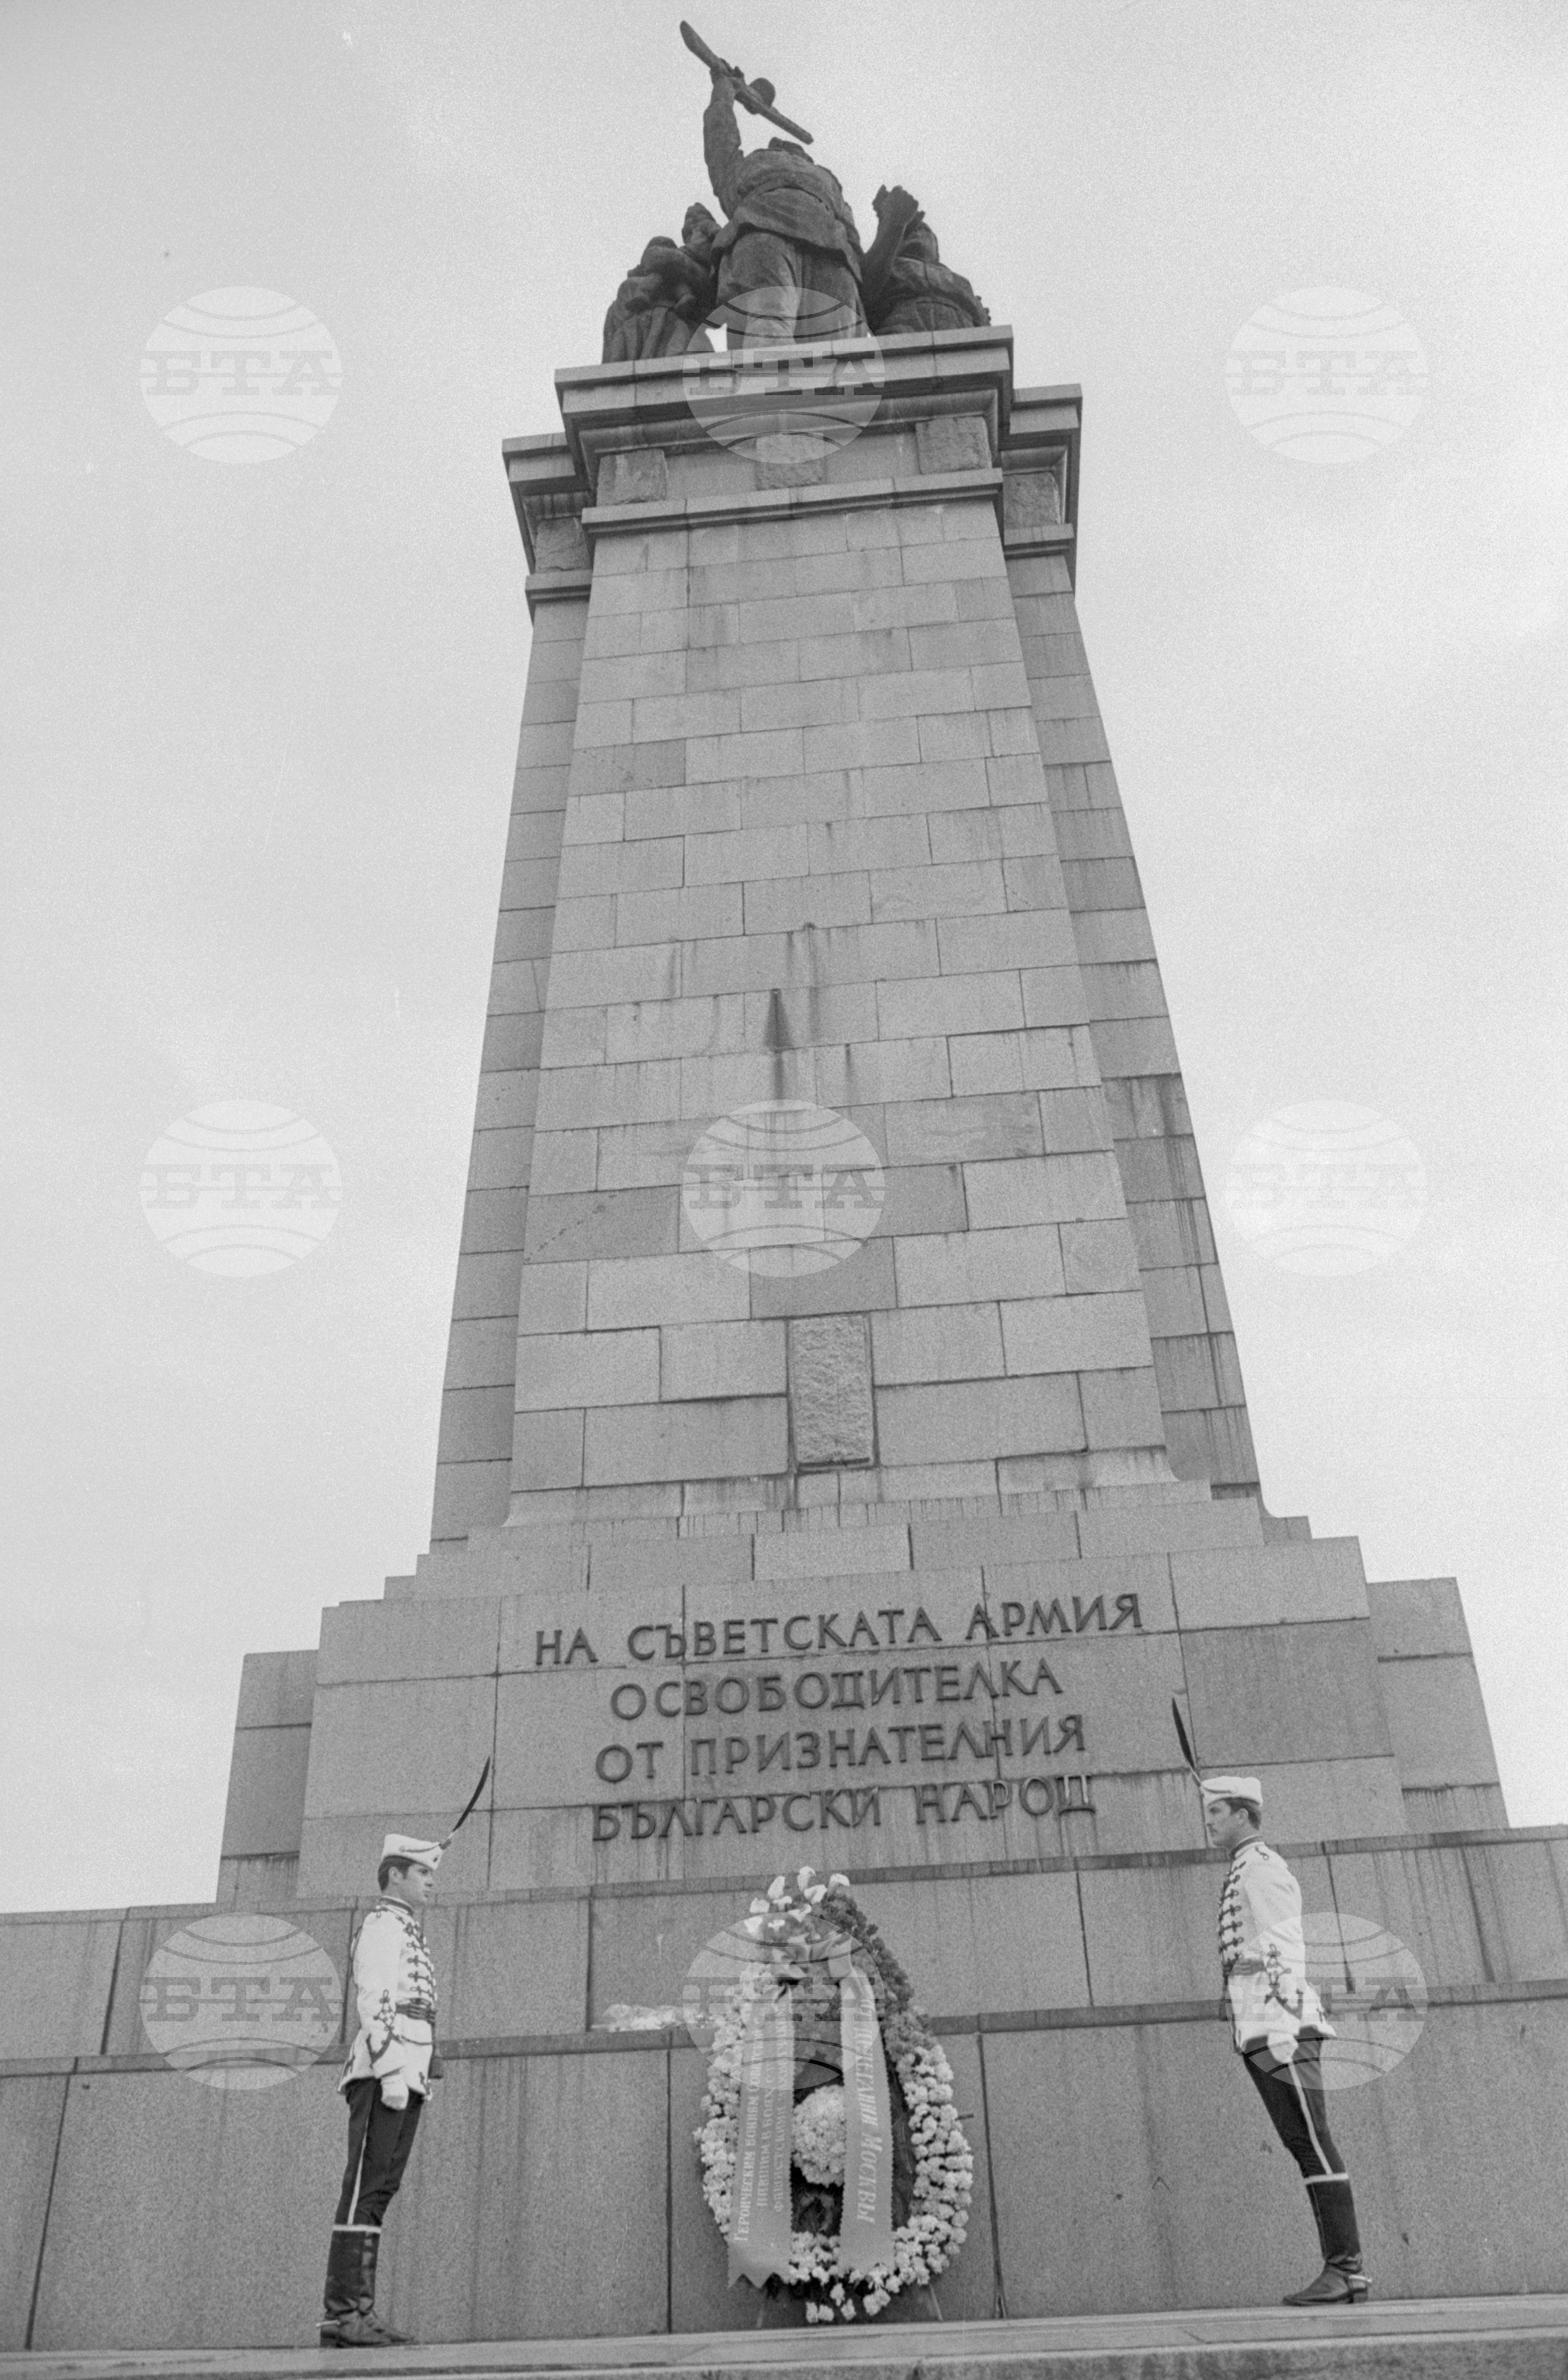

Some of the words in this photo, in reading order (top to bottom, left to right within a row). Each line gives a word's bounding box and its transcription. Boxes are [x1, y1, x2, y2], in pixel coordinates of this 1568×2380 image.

[535, 1629, 598, 1665] НА
[627, 1606, 942, 1661] СЪВЕТСКАТА
[965, 1593, 1143, 1640] АРМИЯ
[610, 1658, 1063, 1720] ОСВОБОДИТЕЛКА
[595, 1741, 663, 1783] ОТ
[690, 1714, 1087, 1777] ПРИЗНАТЕЛНИЯ
[593, 1786, 882, 1842] БЪЛГАРСКИ
[913, 1774, 1097, 1825] НАРОД
